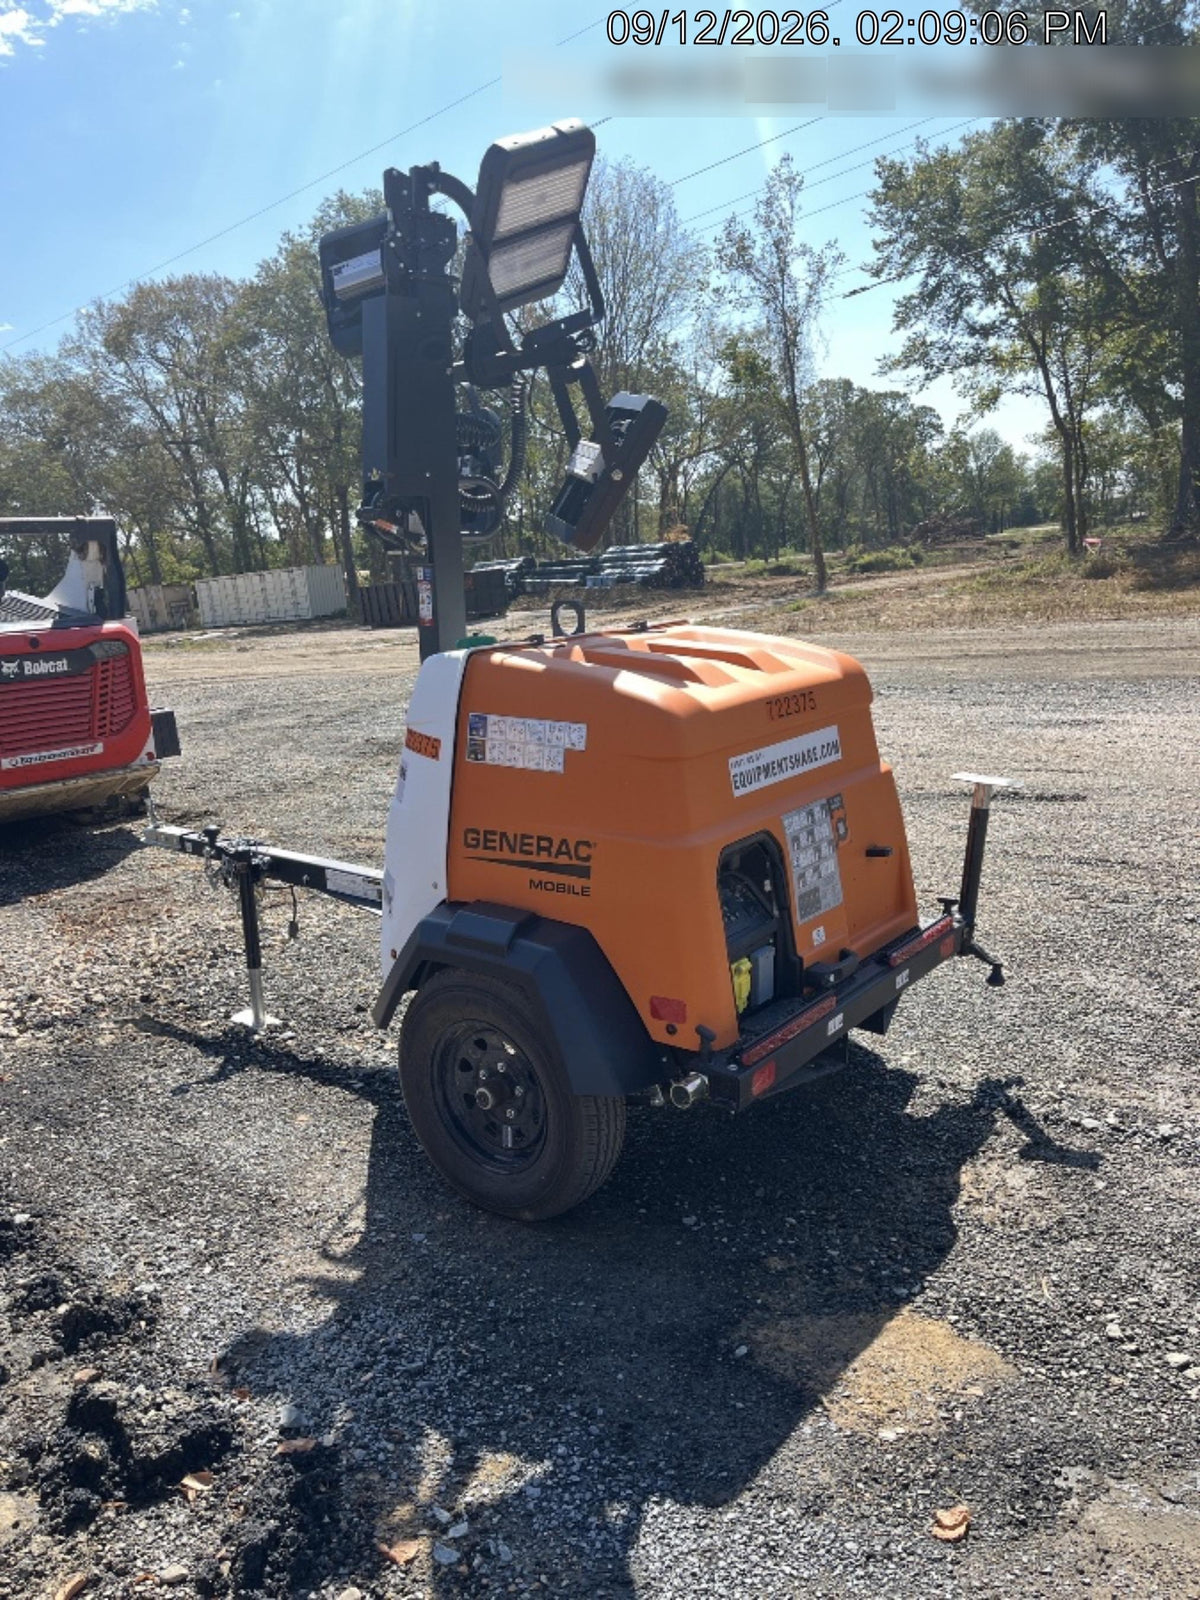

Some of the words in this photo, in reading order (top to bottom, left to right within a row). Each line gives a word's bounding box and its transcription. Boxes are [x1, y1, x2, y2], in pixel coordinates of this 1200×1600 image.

[23, 657, 69, 676] Bobcat
[765, 690, 817, 721] 722375
[732, 739, 840, 790] EQUIPMENTSHARE.COM
[463, 827, 593, 863] GENERAC
[529, 878, 592, 897] MOBILE
